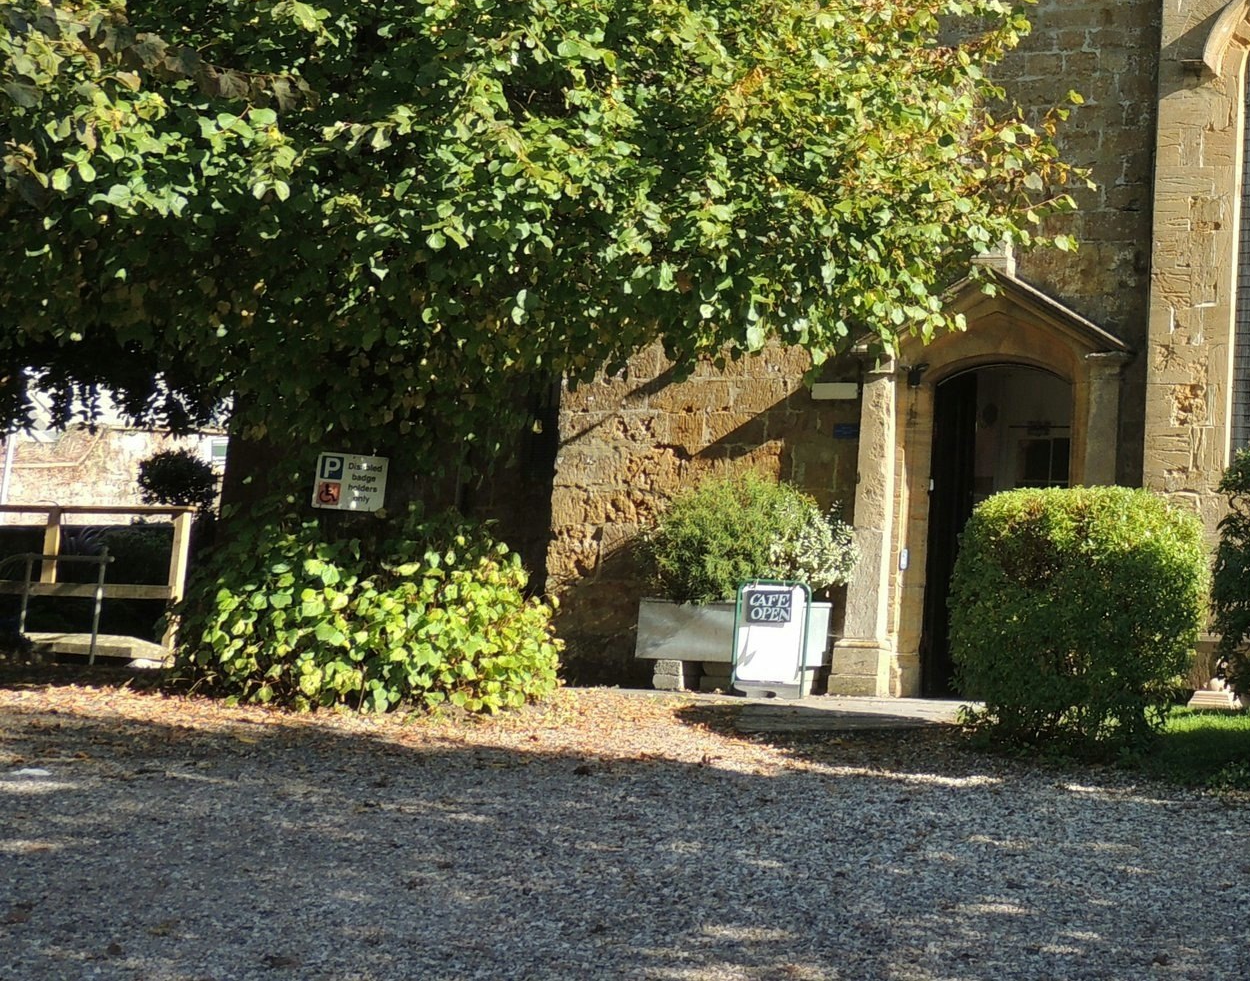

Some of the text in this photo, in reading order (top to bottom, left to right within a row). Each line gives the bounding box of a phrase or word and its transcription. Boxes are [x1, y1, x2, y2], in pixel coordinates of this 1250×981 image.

[323, 457, 341, 478] P
[351, 474, 377, 484] badge
[347, 484, 378, 493] holders
[749, 593, 790, 608] CAFE
[750, 606, 791, 622] OPEN
